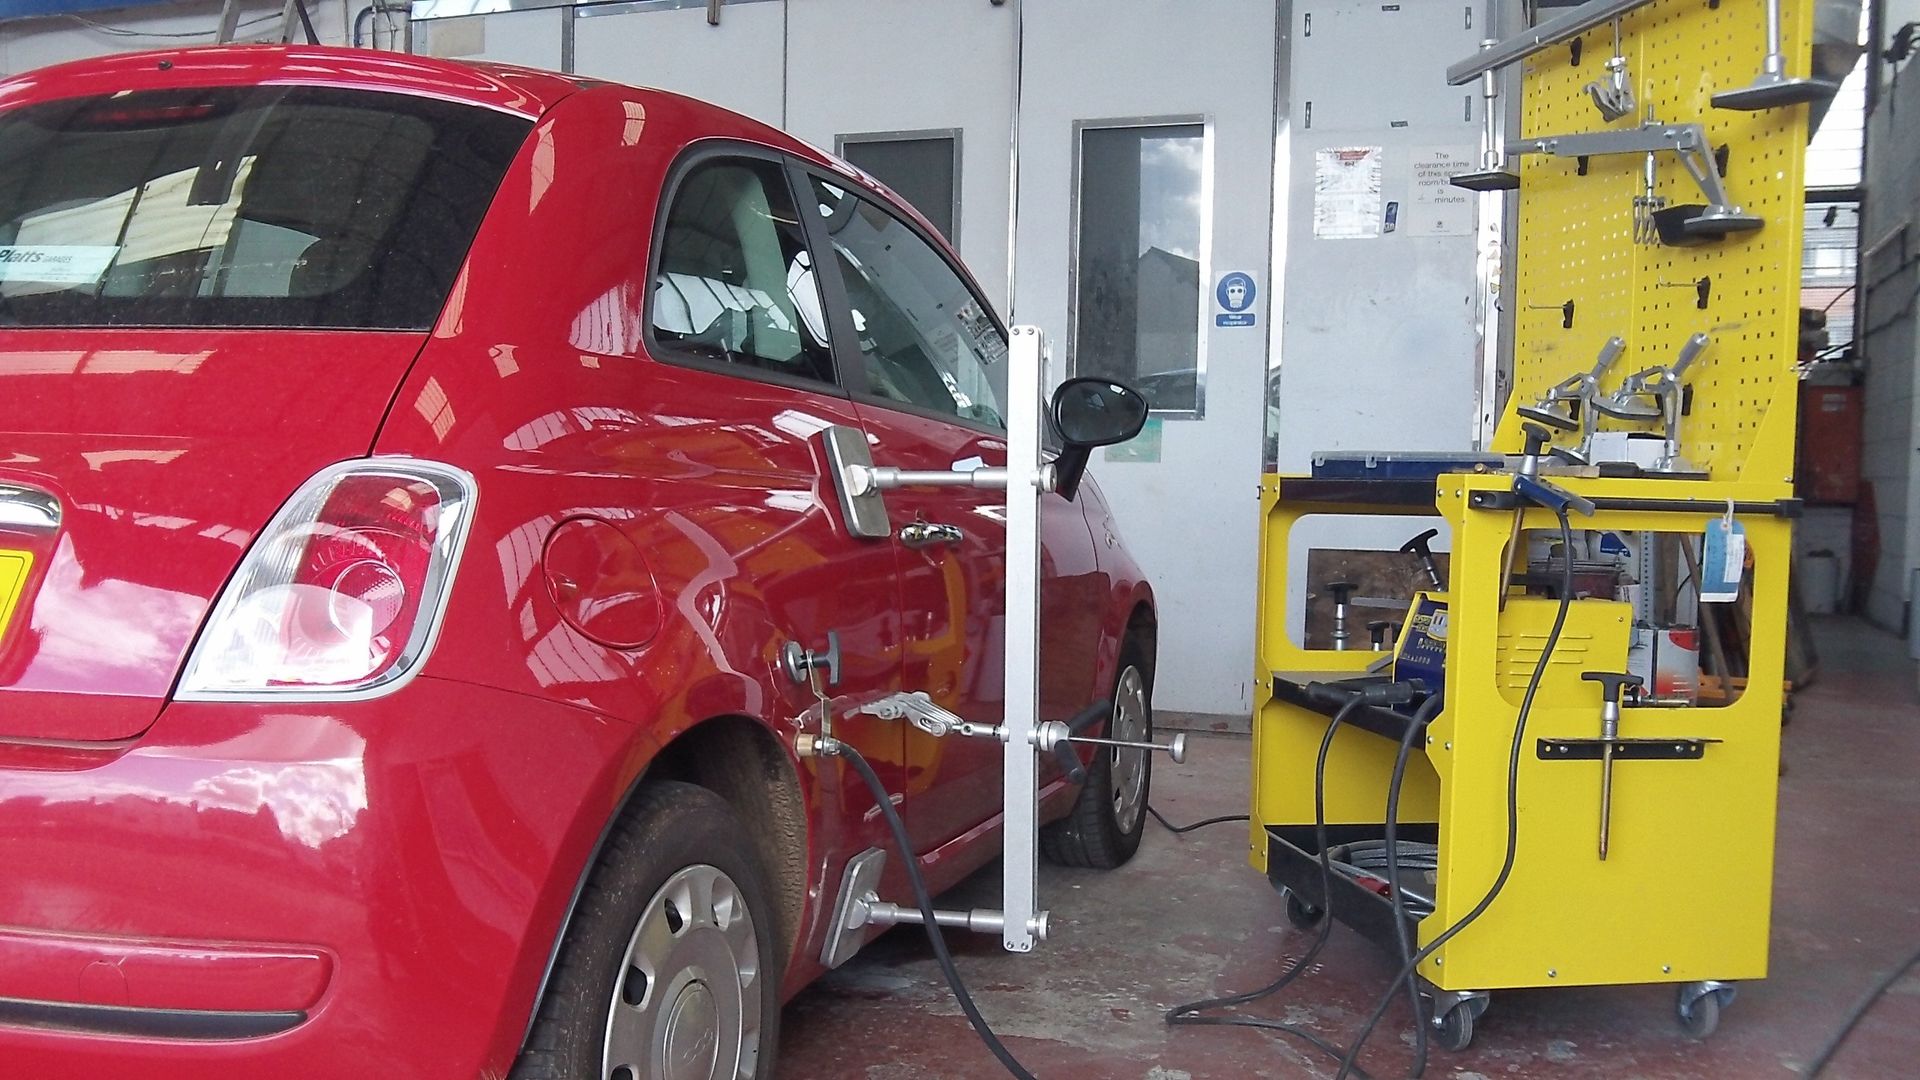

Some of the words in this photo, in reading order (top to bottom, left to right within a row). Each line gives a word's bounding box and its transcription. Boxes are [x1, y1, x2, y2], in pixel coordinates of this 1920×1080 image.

[1414, 161, 1451, 169] clearance
[1453, 160, 1470, 168] time
[1434, 196, 1465, 204] minutes
[0, 249, 44, 262] Platts
